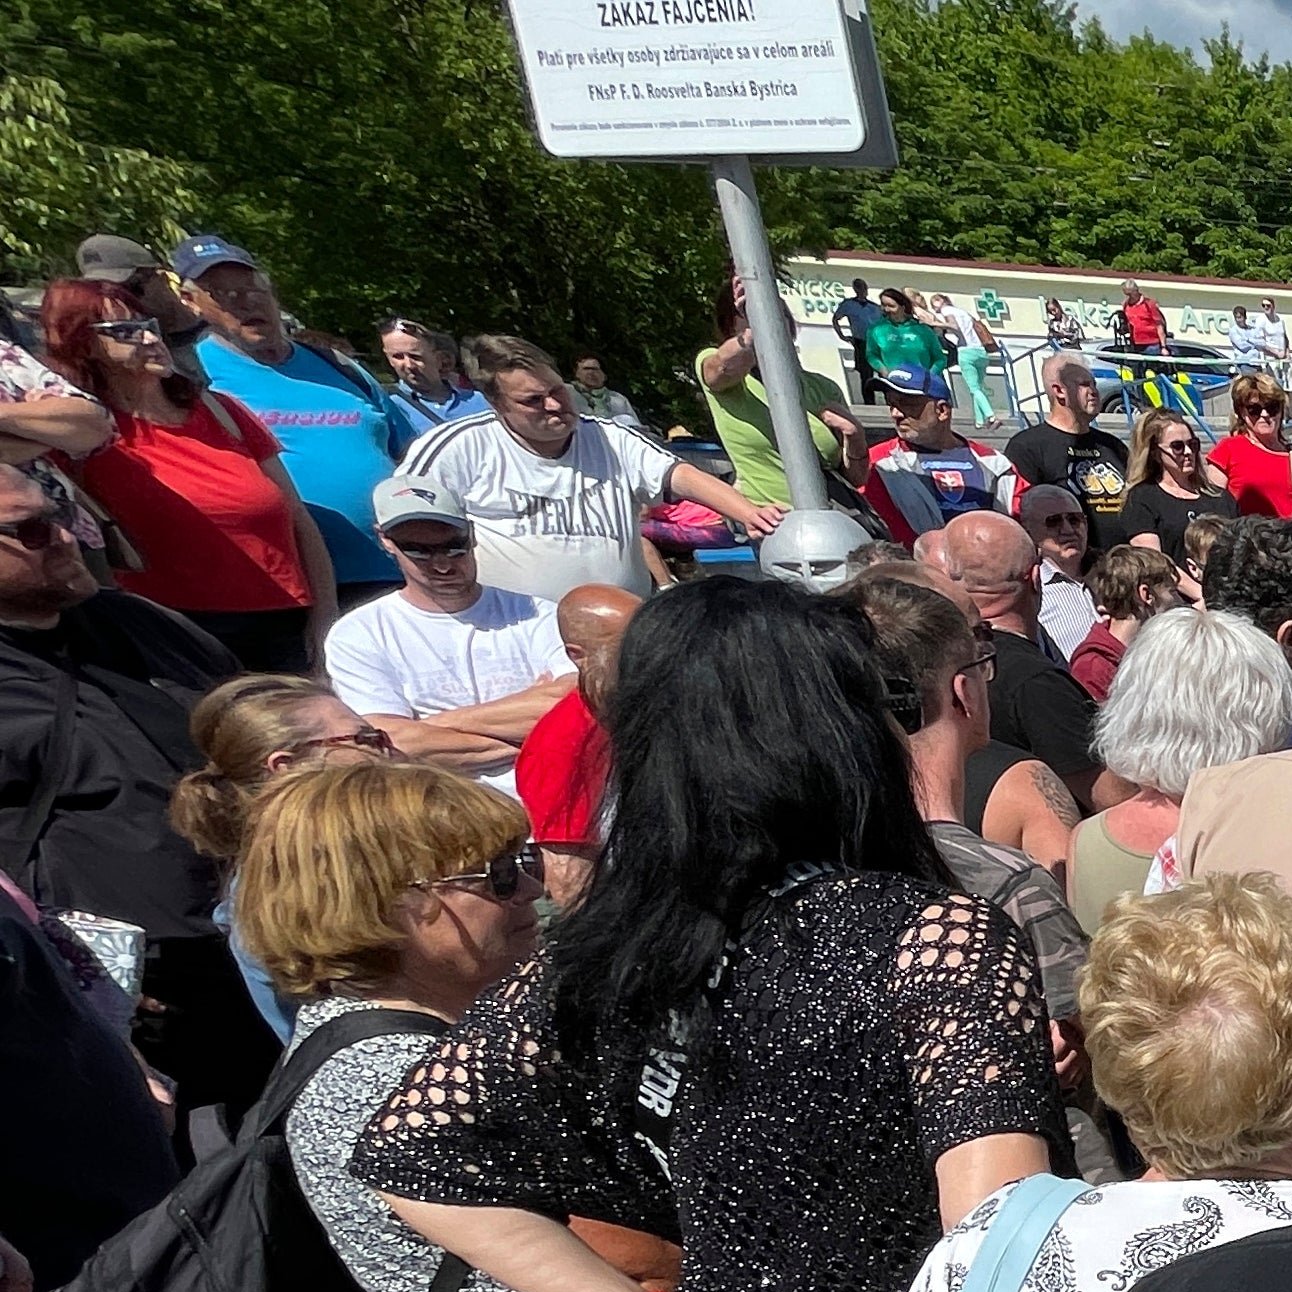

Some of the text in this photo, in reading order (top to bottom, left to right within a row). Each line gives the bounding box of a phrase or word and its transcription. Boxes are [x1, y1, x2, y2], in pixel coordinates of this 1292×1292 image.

[566, 52, 585, 70] pre
[587, 47, 625, 68] všetky
[628, 46, 660, 67] osoby
[737, 46, 751, 60] sa
[752, 45, 760, 58] v
[763, 42, 798, 59] celom
[587, 79, 798, 101] FNsP F. D. Roosvelta Banská Bystrica
